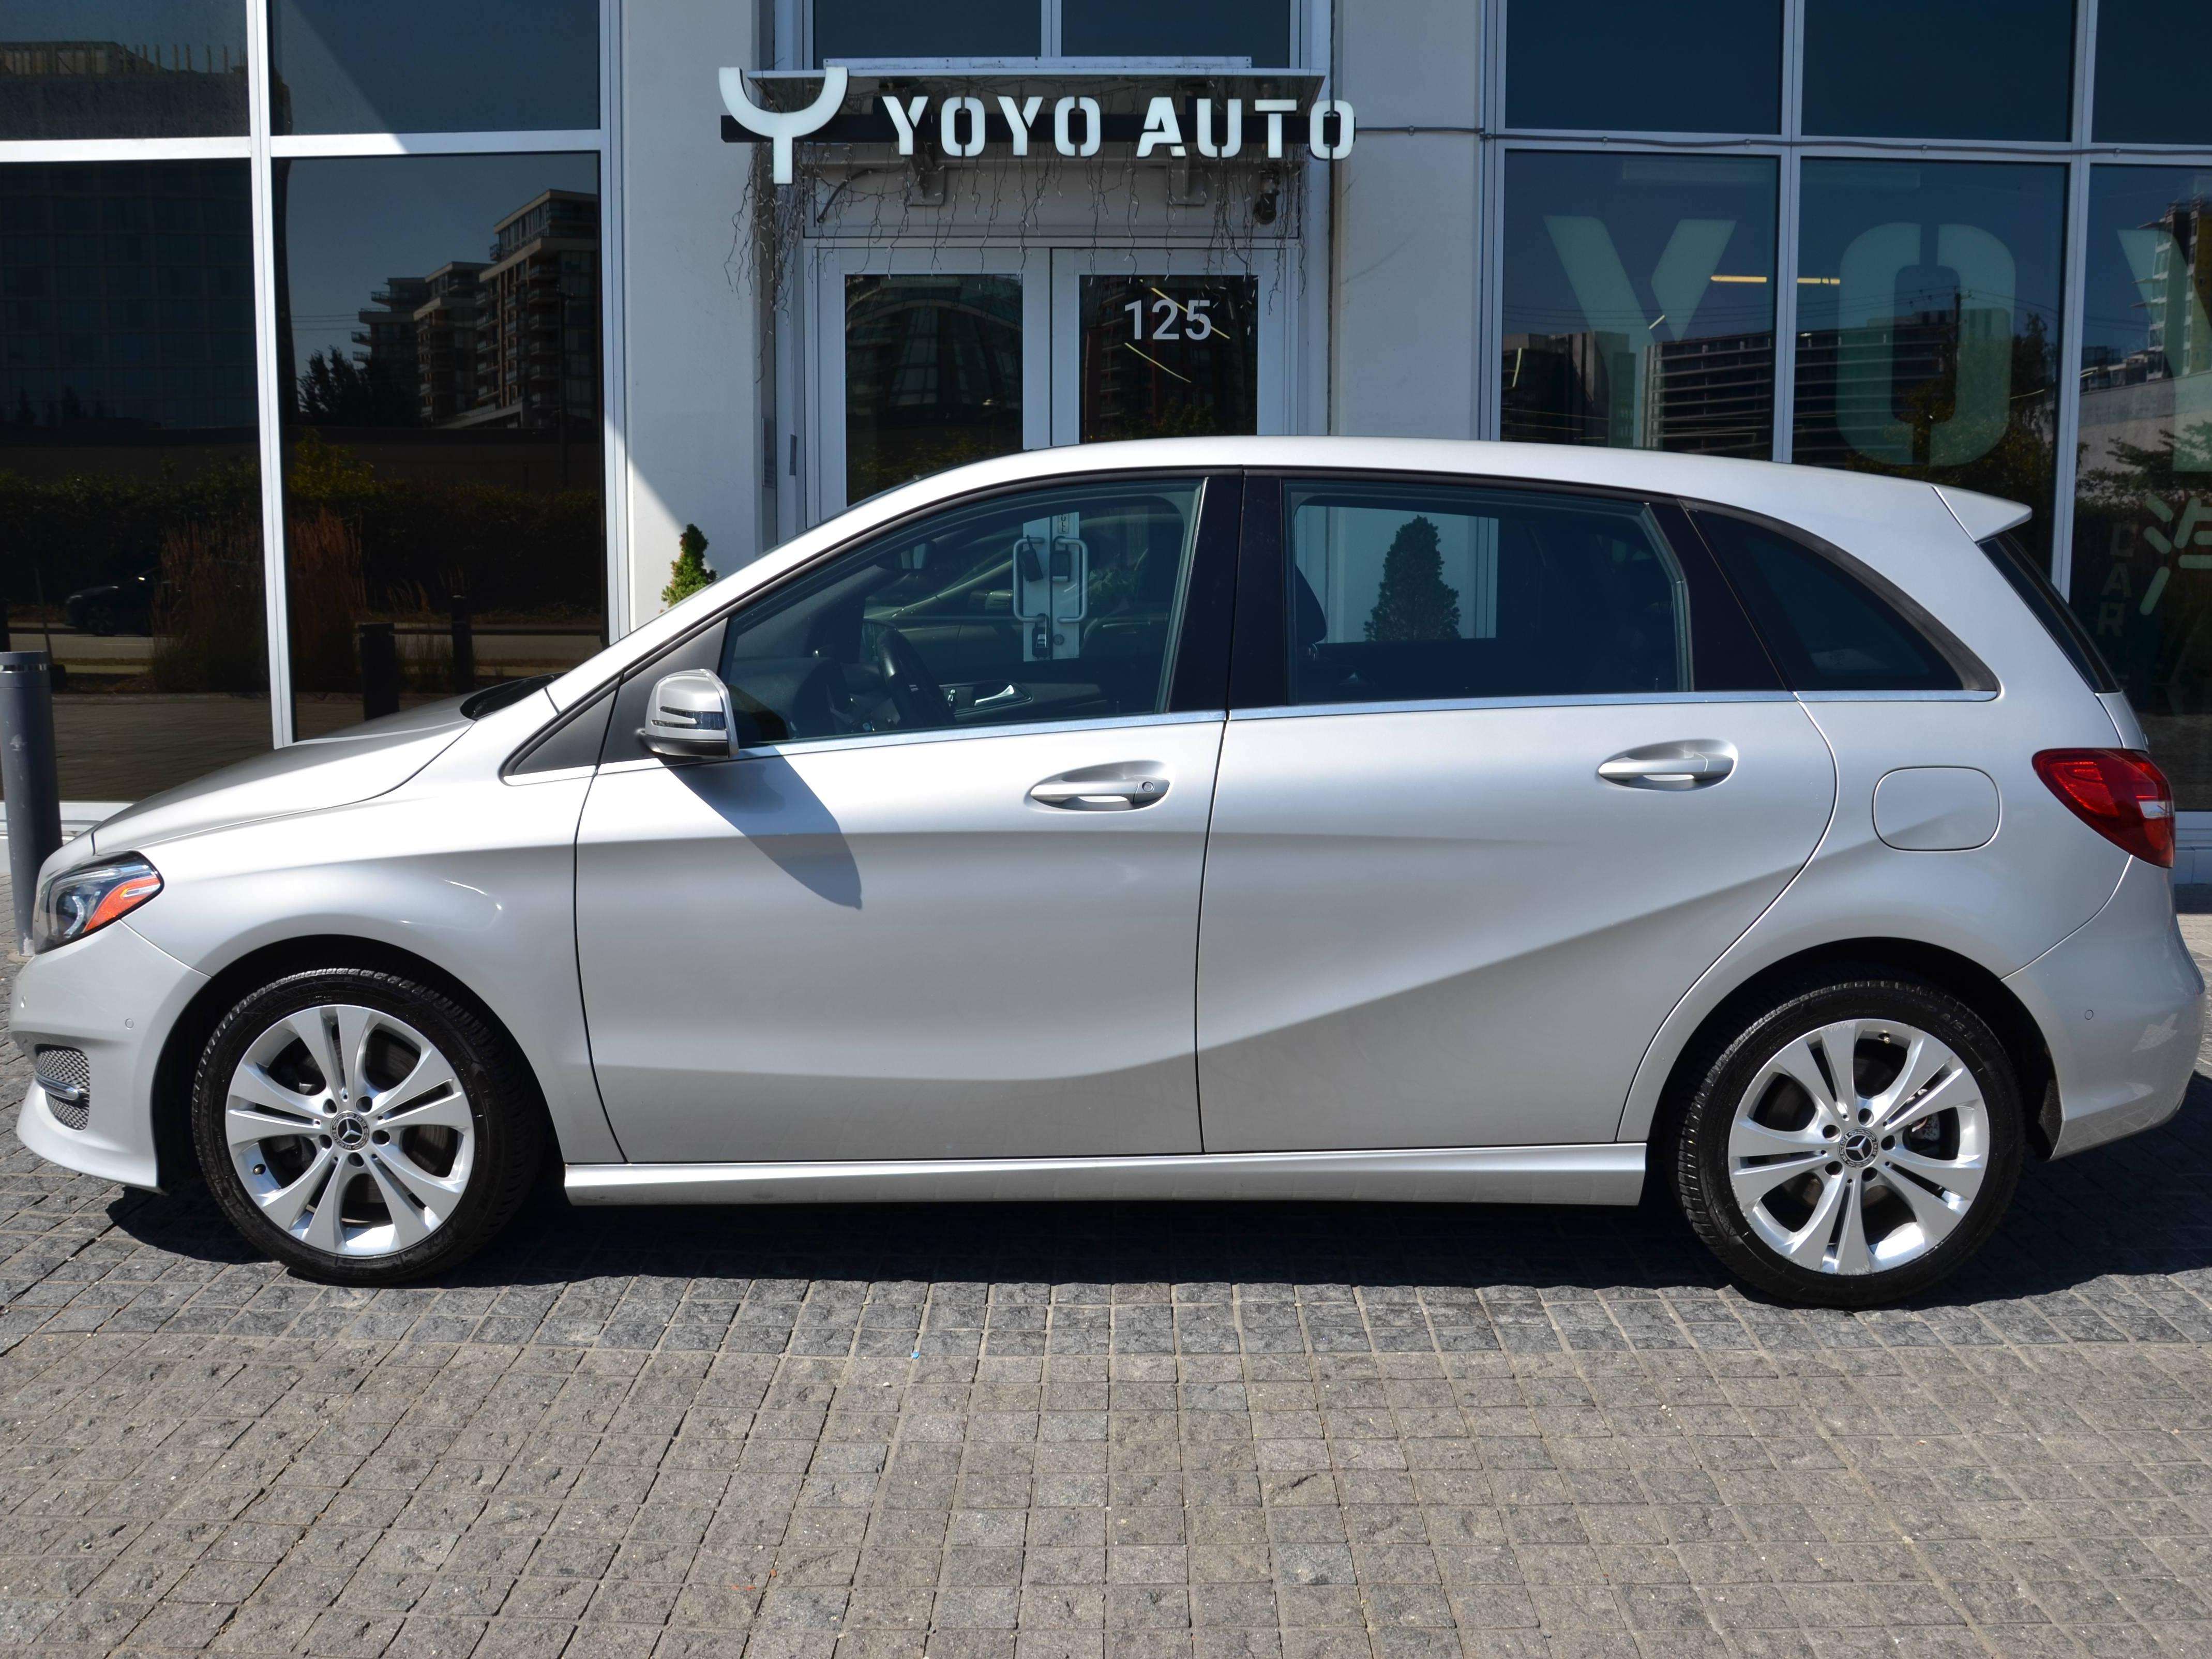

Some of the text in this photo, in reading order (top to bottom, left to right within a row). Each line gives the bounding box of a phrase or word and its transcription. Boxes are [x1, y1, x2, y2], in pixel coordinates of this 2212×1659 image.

[882, 96, 1357, 159] YOYO AUTO
[1125, 299, 1211, 340] 125
